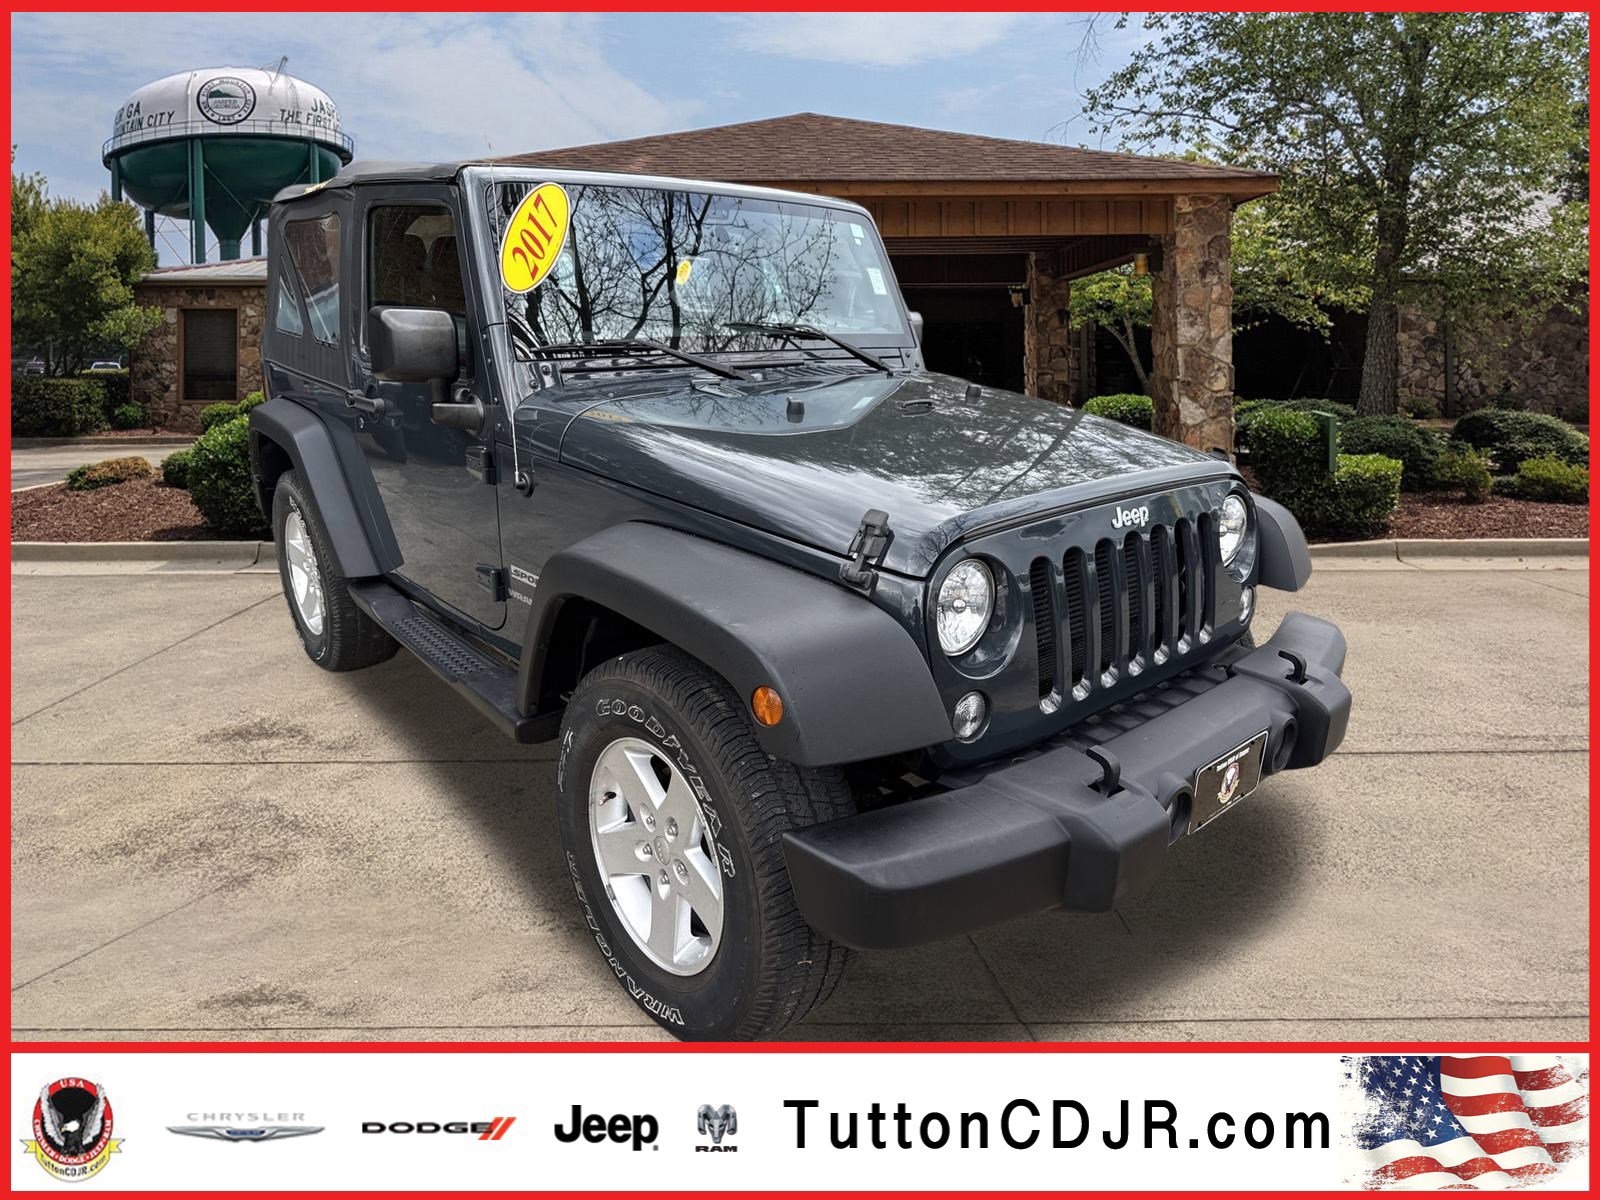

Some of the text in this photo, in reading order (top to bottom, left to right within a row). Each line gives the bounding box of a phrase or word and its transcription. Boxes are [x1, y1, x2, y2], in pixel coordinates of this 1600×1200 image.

[126, 101, 141, 119] GA
[147, 110, 176, 127] CITY
[279, 108, 302, 124] THE
[512, 193, 557, 280] 2017
[1111, 505, 1150, 529] Jeep
[595, 698, 736, 878] GOODYEAR
[566, 850, 685, 1027] WRANGLER
